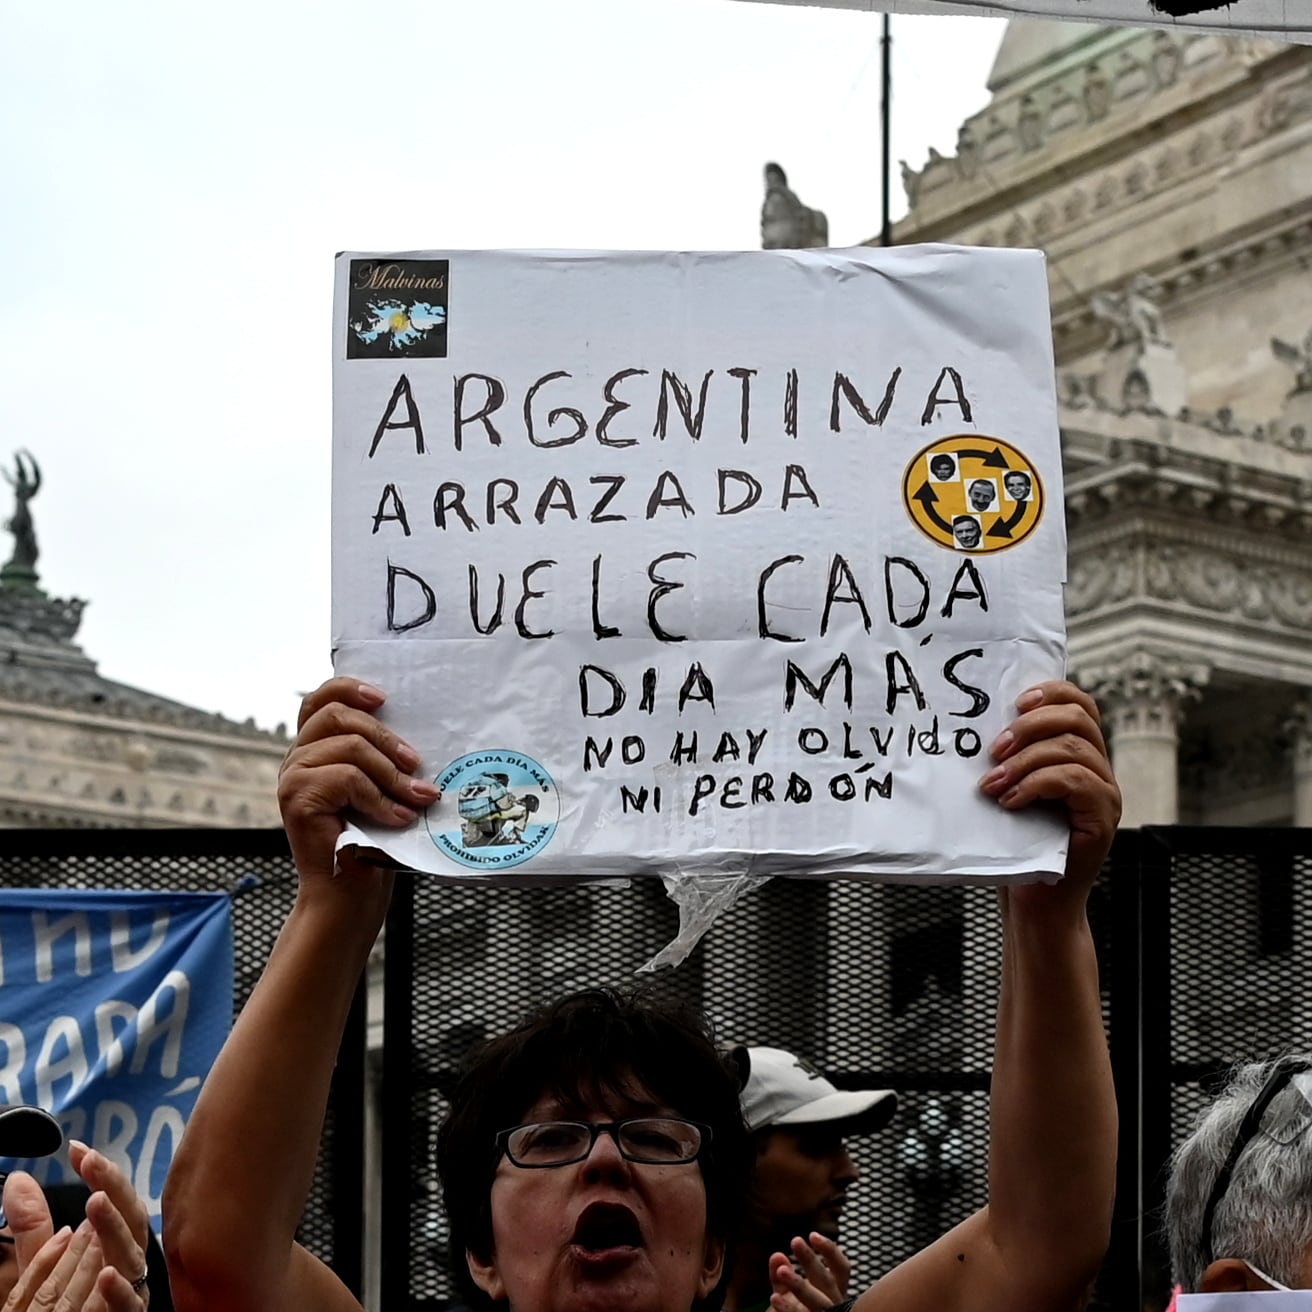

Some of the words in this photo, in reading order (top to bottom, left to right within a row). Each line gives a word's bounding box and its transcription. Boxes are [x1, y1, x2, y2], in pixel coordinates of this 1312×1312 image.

[354, 263, 444, 290] Malvinas
[367, 367, 977, 458] ARGENTINA
[373, 464, 819, 536] ARRAZADA
[387, 552, 695, 642] DUELE
[758, 553, 988, 643] CADA
[579, 662, 714, 718] DIA
[784, 633, 990, 718] MÁS
[465, 755, 503, 768] CADA
[584, 736, 645, 771] NO
[670, 729, 767, 766] HAY
[621, 785, 661, 814] NI
[690, 763, 892, 816] PERDÓN
[439, 834, 501, 864] PROHIBIDO
[503, 826, 550, 863] OLVIDAR
